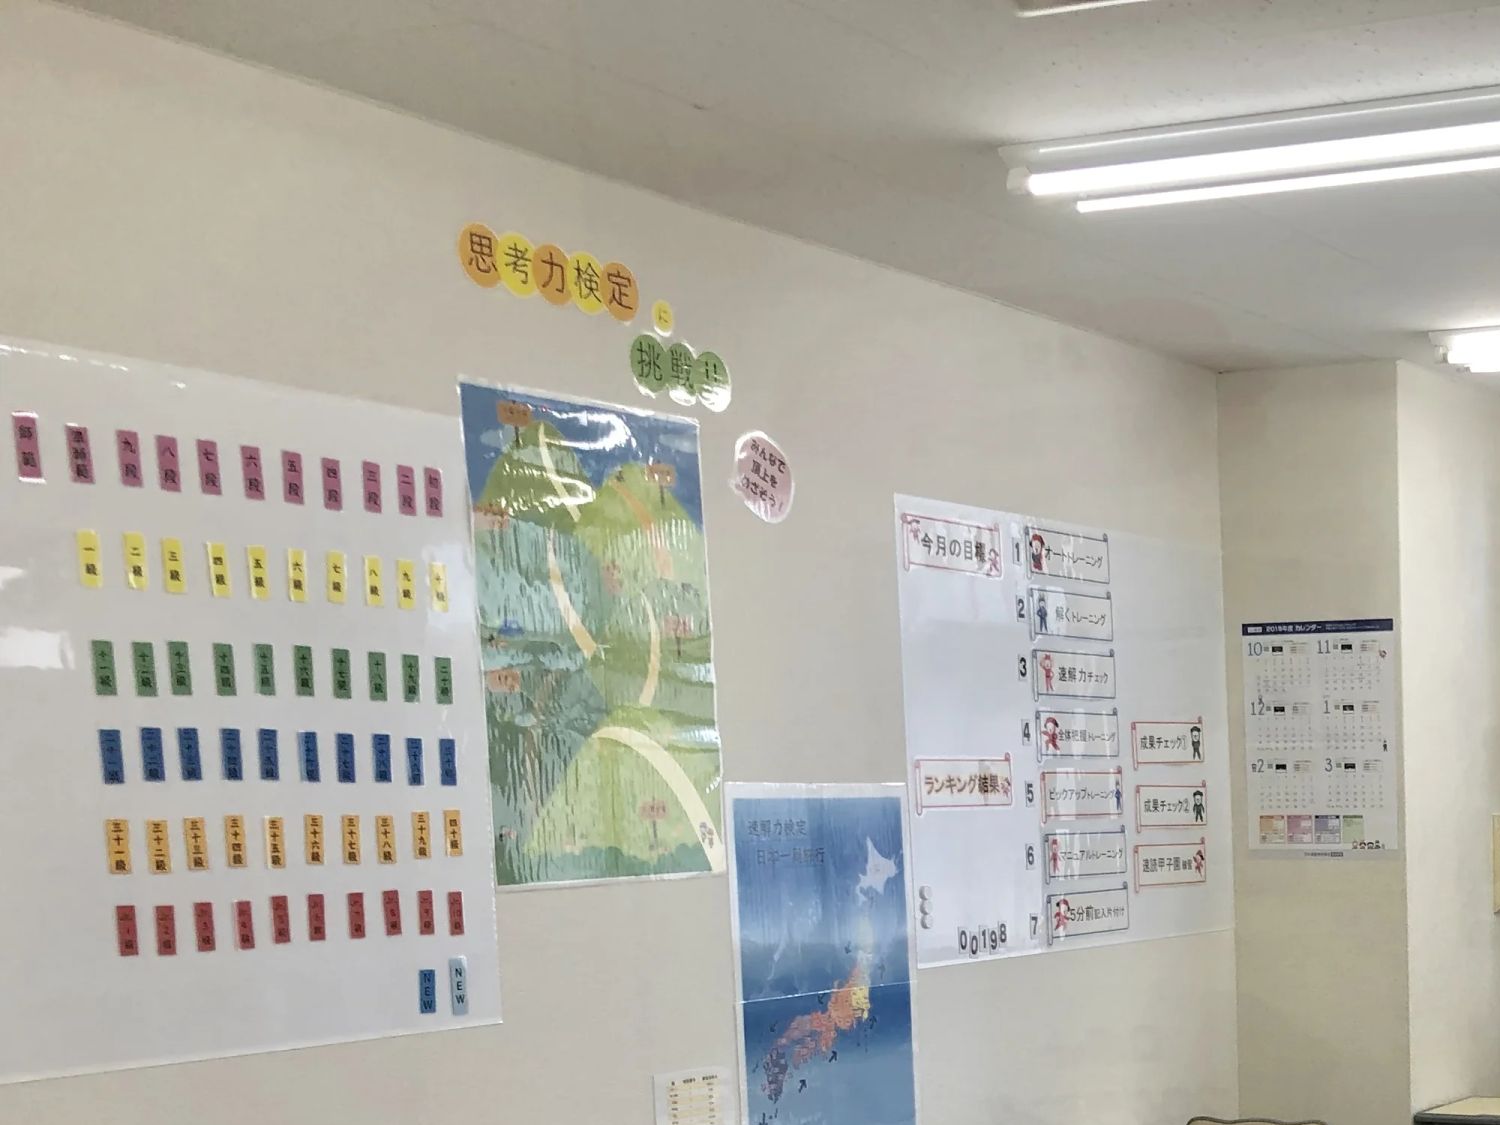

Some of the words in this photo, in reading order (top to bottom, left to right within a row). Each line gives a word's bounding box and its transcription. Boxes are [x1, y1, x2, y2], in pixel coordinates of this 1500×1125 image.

[467, 231, 633, 310] 思考力検定
[658, 310, 668, 323] に
[121, 437, 137, 479] 九段
[161, 447, 178, 485] 八段
[202, 449, 219, 487] 七段
[750, 439, 786, 473] みんなで
[245, 454, 261, 493] 六段
[287, 459, 301, 497] 五段
[325, 467, 339, 503] 四段
[366, 470, 379, 506] 三段
[399, 474, 413, 509] 二段
[83, 547, 98, 576] 一級
[130, 547, 144, 577] 二級
[921, 533, 987, 563] 今月の目標
[1014, 542, 1020, 562] 1
[1045, 546, 1104, 569] オートトレーニング
[168, 551, 182, 581] 三級
[213, 556, 227, 586] 四級
[253, 558, 265, 588] 五級
[292, 561, 304, 591] 六級
[332, 563, 342, 592] 七級
[369, 568, 380, 597] 八級
[402, 572, 413, 599] 九級
[1017, 598, 1025, 619] 2
[1247, 642, 1263, 657] 10
[1317, 640, 1331, 654] 11
[1019, 657, 1027, 678] 3
[1323, 700, 1331, 714] 1
[1023, 722, 1031, 742] 4
[1257, 759, 1264, 773] 2
[1325, 758, 1333, 772] 3
[924, 774, 1000, 796] ランキング結果
[1026, 783, 1034, 803] 5
[111, 822, 127, 871] 三十一級
[152, 823, 167, 871] 三十二級
[230, 818, 243, 865] 三十四級
[310, 817, 321, 862] 三十六級
[347, 817, 358, 862] 三十七級
[381, 817, 394, 862] 三十八級
[417, 814, 428, 857] 三十九級
[449, 818, 460, 849] 四十級
[1027, 845, 1035, 866] 6
[1030, 915, 1038, 935] 7
[422, 973, 433, 1011] NEW
[455, 968, 465, 1004] NEW
